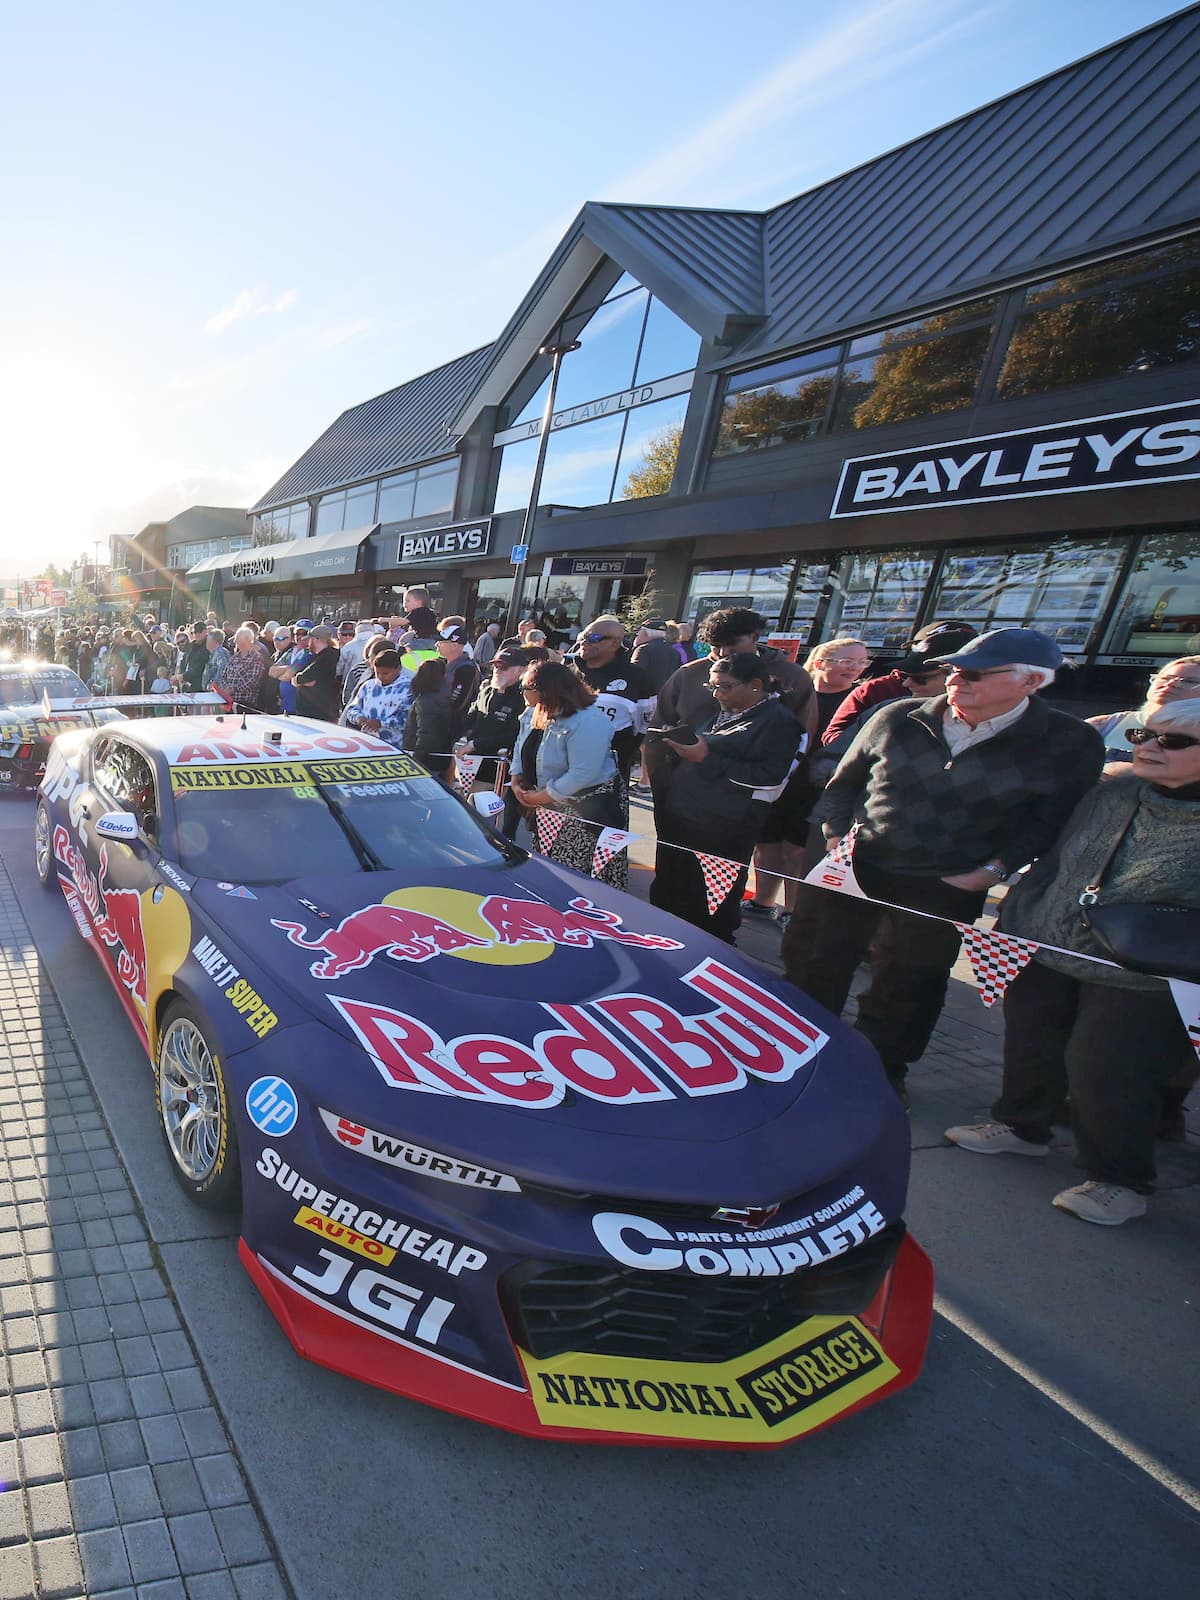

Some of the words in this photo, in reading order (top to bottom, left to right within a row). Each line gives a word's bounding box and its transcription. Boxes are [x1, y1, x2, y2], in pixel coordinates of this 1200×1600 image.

[570, 400, 609, 422] LAW
[618, 387, 654, 408] LTD
[853, 418, 1200, 503] BAYLEYS
[403, 528, 482, 556] BAYLEYS
[575, 561, 622, 571] BAYLEYS
[172, 767, 305, 788] NATIONAL
[313, 759, 420, 783] STORAGE
[176, 736, 393, 763] AMPOL
[294, 785, 319, 799] 88
[336, 782, 411, 798] Feeney
[161, 864, 192, 893] DUNLOP
[192, 936, 229, 981] MAKE
[214, 962, 240, 988] IT
[225, 979, 279, 1039] SUPER
[325, 993, 677, 1110] Red
[592, 956, 830, 1098] Bull
[249, 1077, 294, 1132] hp
[372, 1136, 502, 1187] WÜRTH
[256, 1147, 488, 1276] SUPERCHEAP
[675, 1231, 733, 1243] PARTS
[746, 1216, 815, 1242] EQUIPMENT
[814, 1184, 866, 1222] SOLUTIONS
[305, 1216, 385, 1257] AUTO
[591, 1200, 887, 1277] COMPLETE
[293, 1247, 455, 1346] JGI
[537, 1372, 753, 1420] NATIONAL
[750, 1330, 874, 1415] STORAGE
